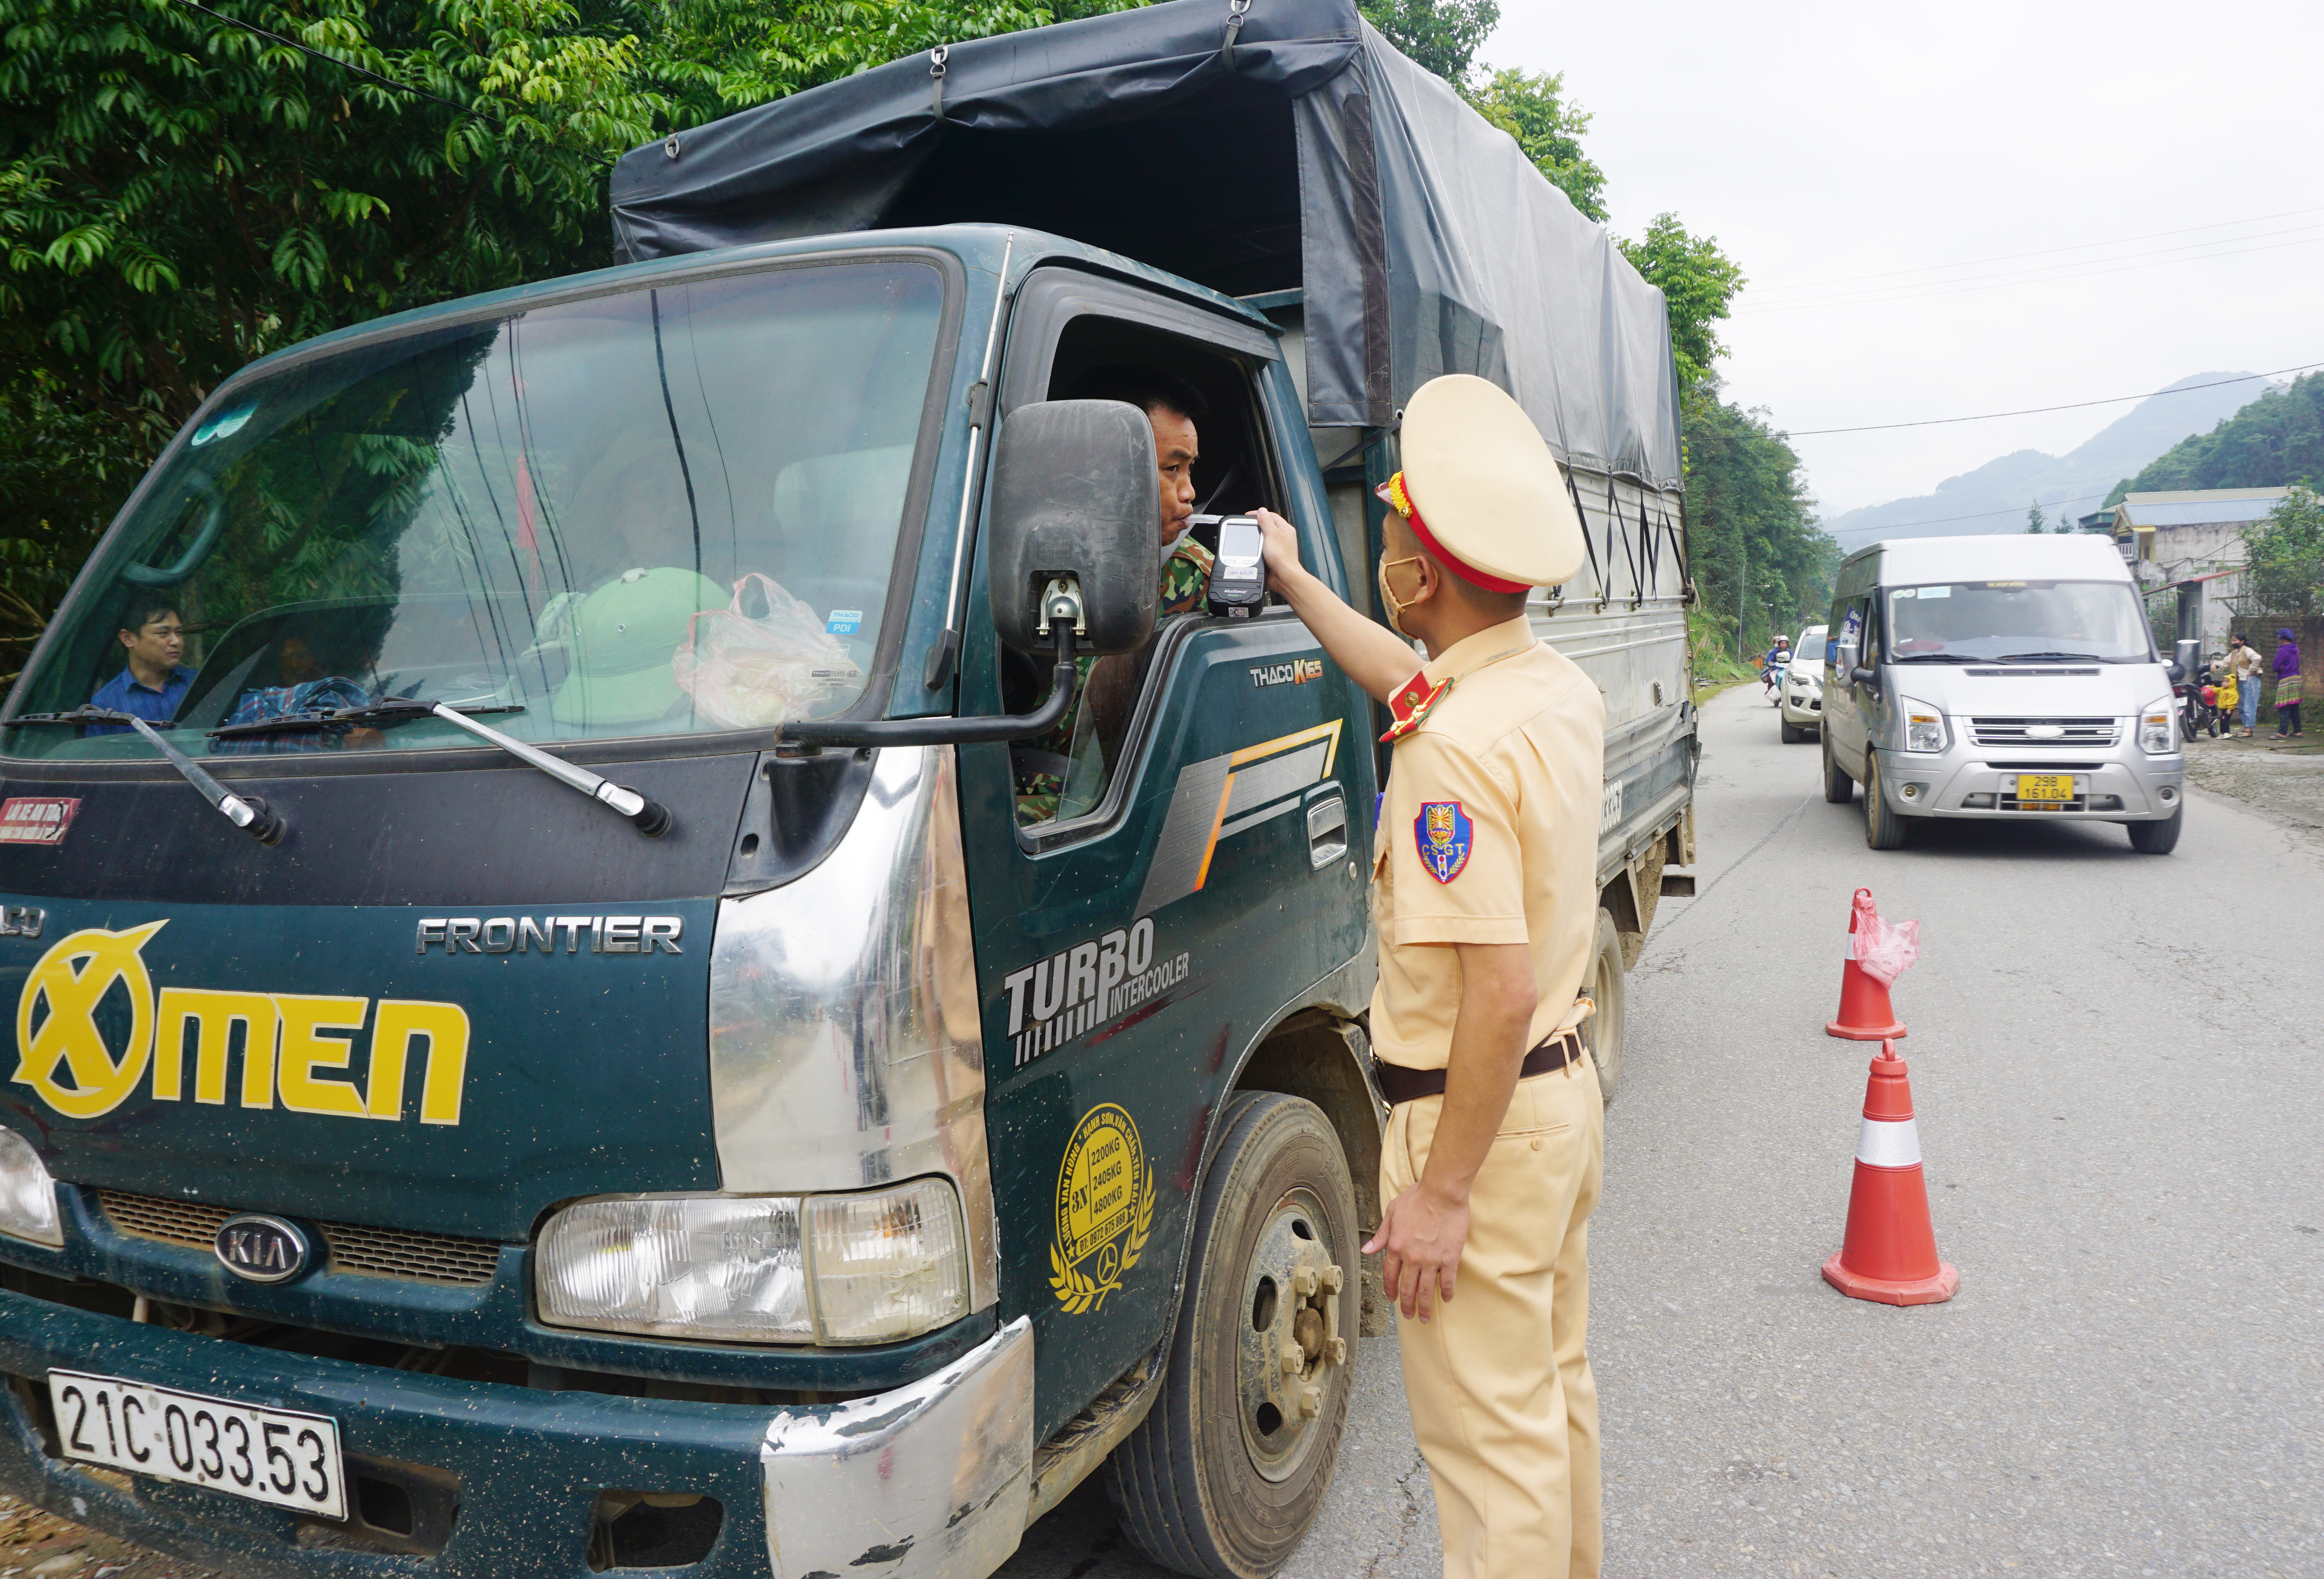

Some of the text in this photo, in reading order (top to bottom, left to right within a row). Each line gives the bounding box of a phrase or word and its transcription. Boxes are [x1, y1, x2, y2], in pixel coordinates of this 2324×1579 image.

[833, 624, 851, 632] PDI
[1250, 659, 1323, 687] THACO K165
[2025, 788, 2067, 799] 161.04
[2034, 776, 2058, 787] 29B
[1422, 843, 1465, 856] CSGT
[415, 916, 684, 954] FRONTIER
[1004, 917, 1155, 1037] TURBO
[1109, 952, 1189, 1018] INTERCOOLER
[1082, 1115, 1100, 1139] HẠNH
[1091, 1137, 1120, 1166] 2200KG
[1093, 1160, 1122, 1191] 2405KG
[1071, 1184, 1088, 1214] 3N
[1094, 1185, 1122, 1215] 4800KG
[1090, 1226, 1104, 1246] 0972
[1105, 1219, 1115, 1235] 675
[1116, 1211, 1126, 1228] 888
[229, 1230, 287, 1269] KIA
